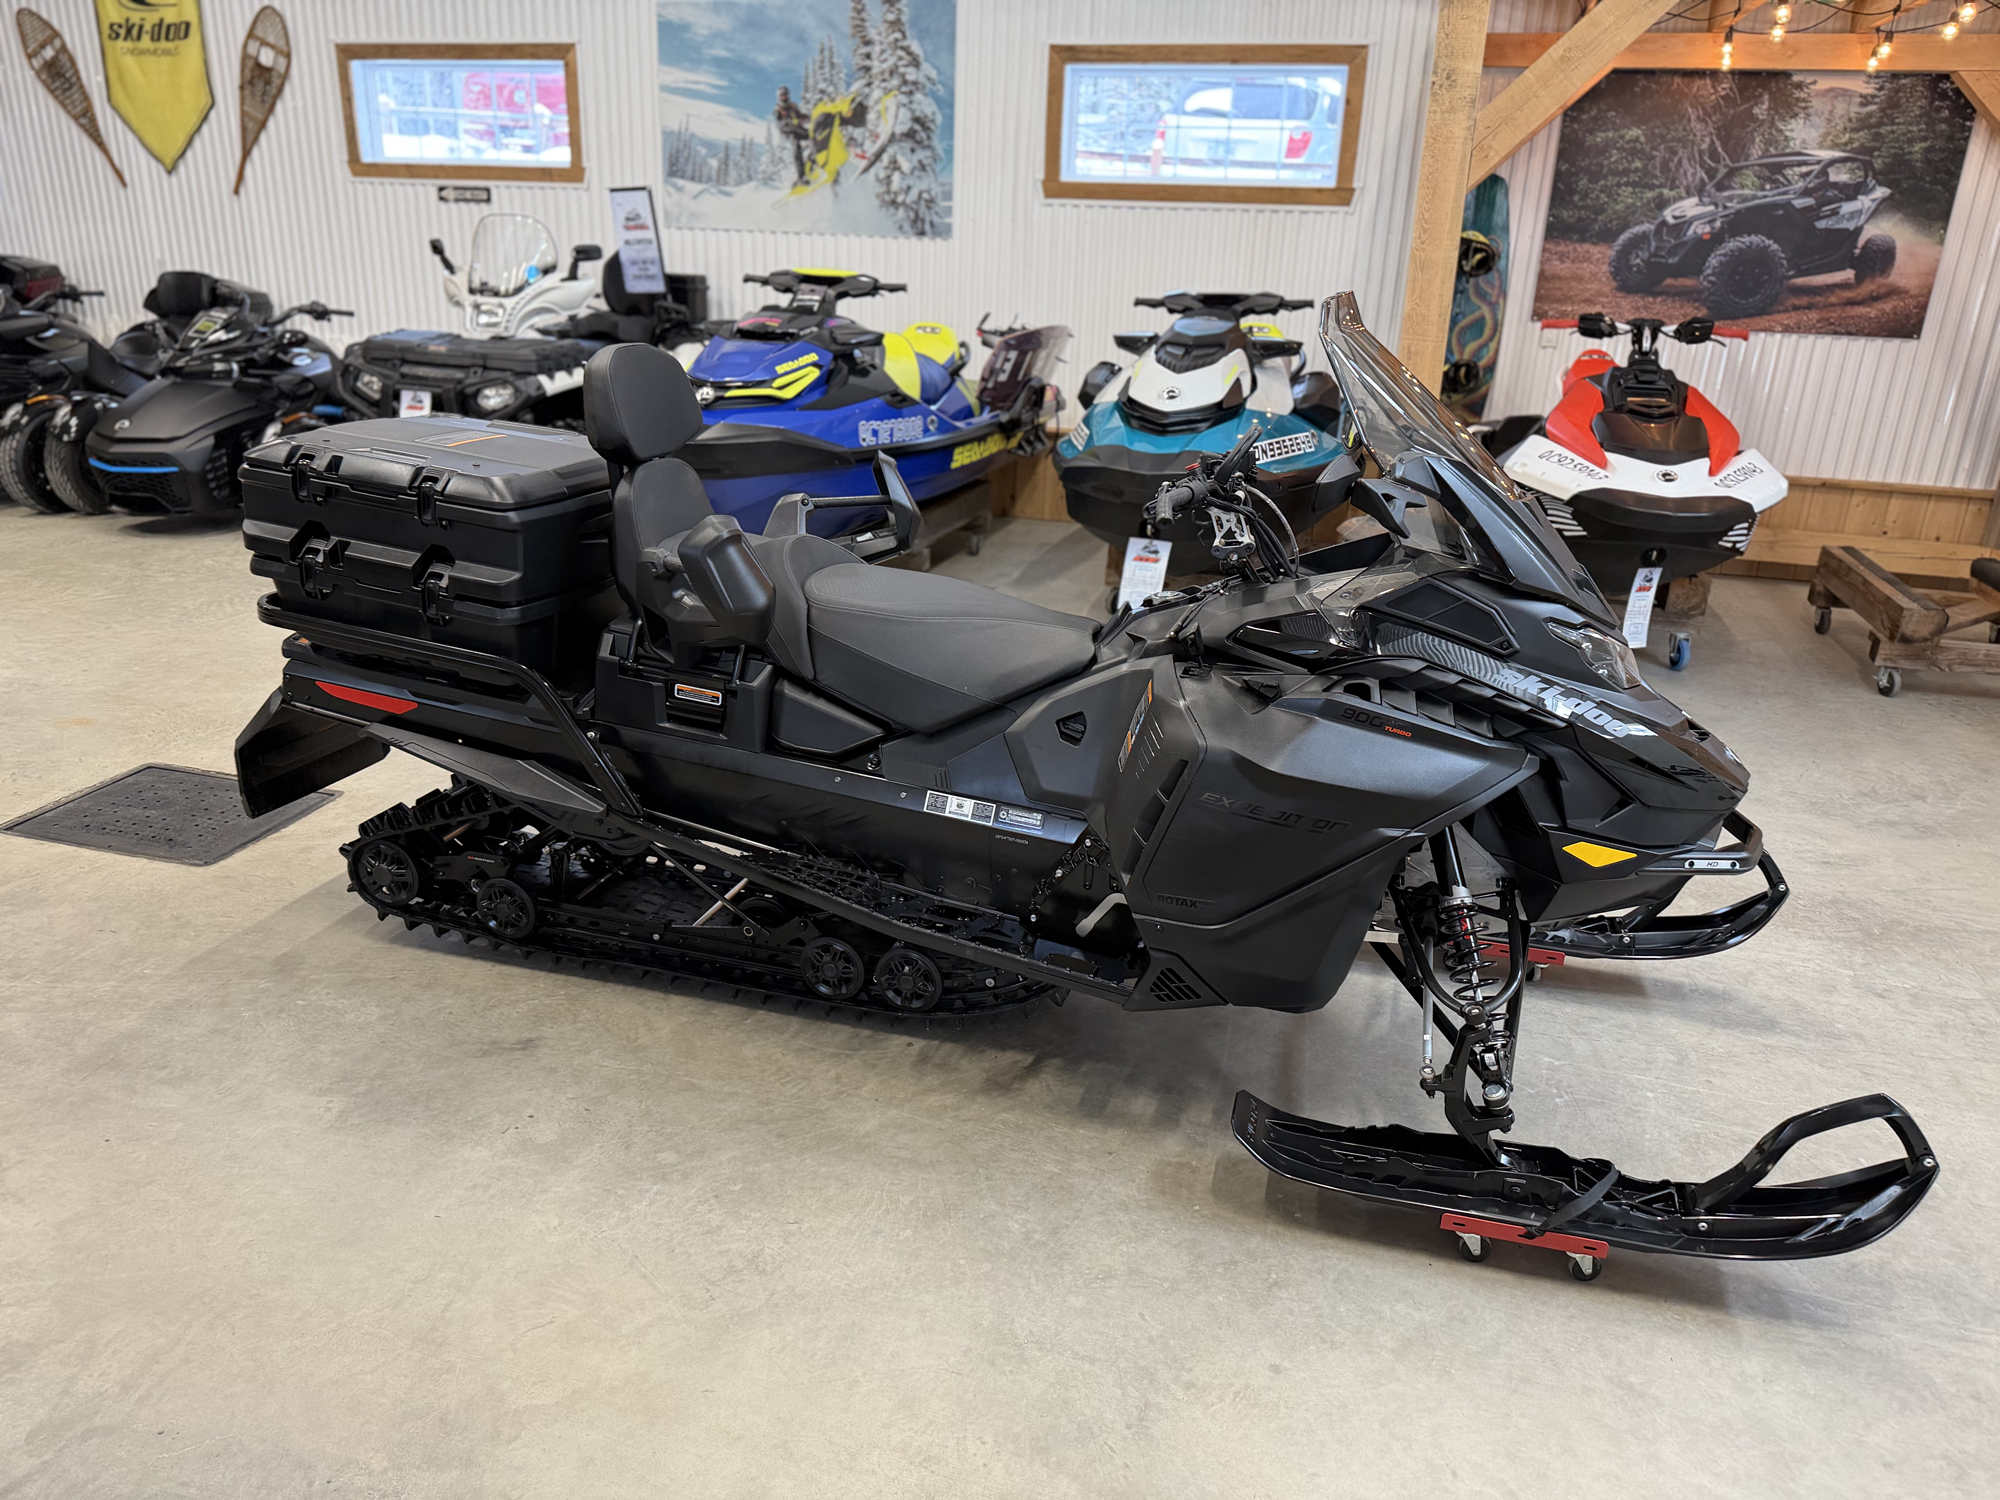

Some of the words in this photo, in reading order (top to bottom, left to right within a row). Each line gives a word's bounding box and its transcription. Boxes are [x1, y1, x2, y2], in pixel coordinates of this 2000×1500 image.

[107, 17, 191, 42] ski-doo
[1340, 707, 1384, 728] 900
[1384, 725, 1412, 737] TURBO
[1157, 894, 1198, 909] ROTAX
